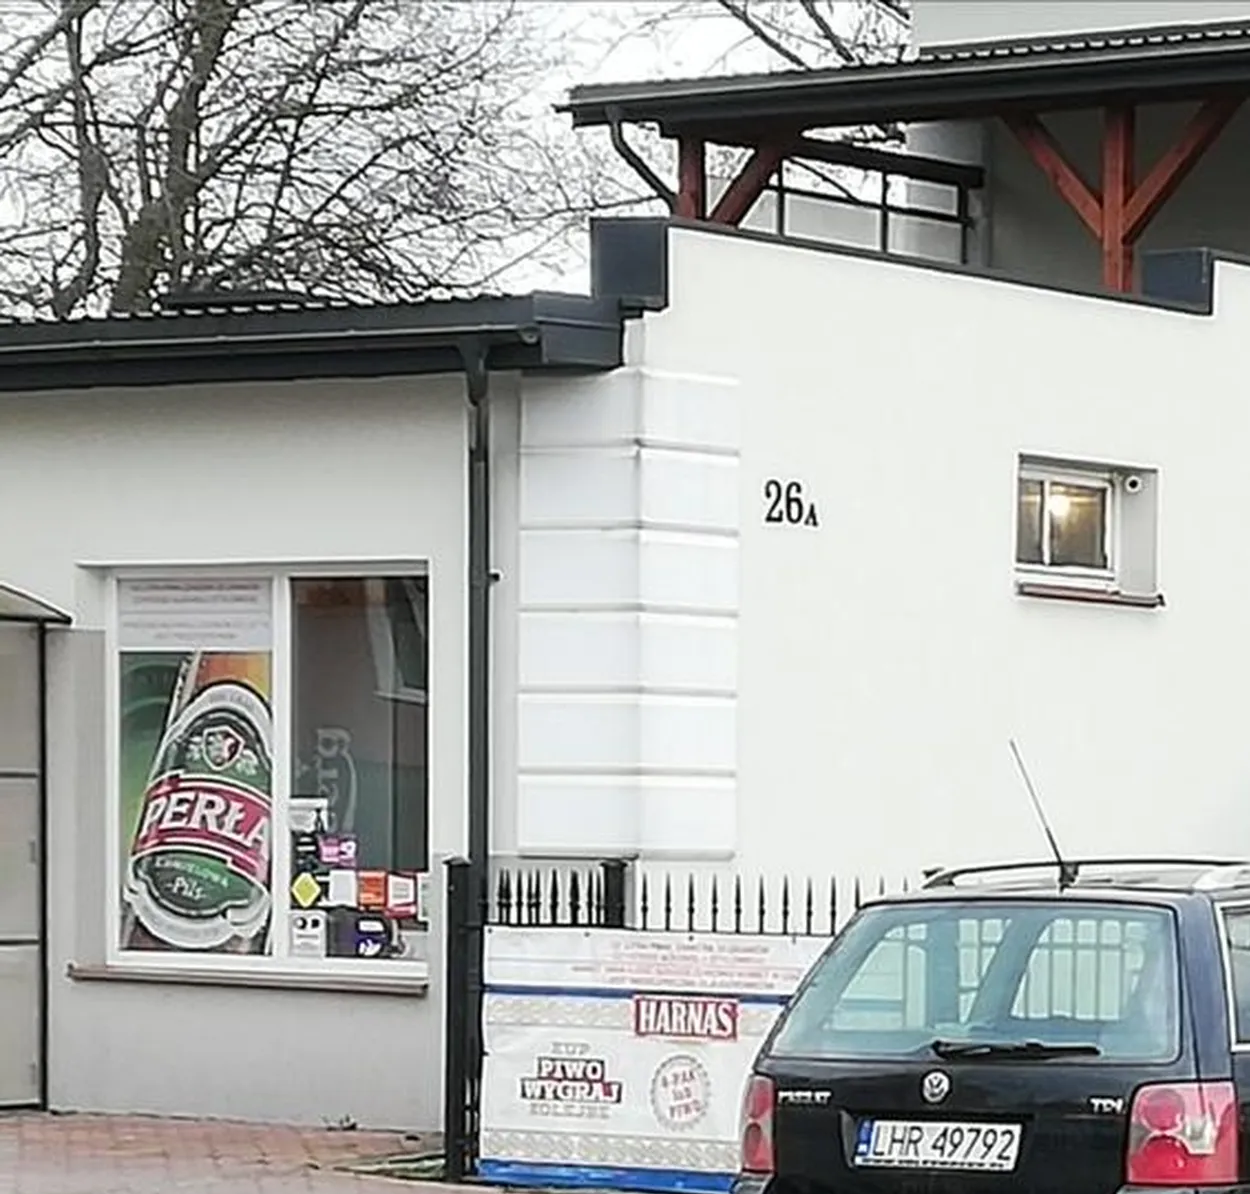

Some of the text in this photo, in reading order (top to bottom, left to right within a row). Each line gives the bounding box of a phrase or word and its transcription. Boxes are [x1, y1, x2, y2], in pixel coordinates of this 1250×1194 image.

[765, 479, 819, 527] 26A
[640, 1000, 733, 1036] HARNAS
[540, 1060, 601, 1080] PIWO
[524, 1080, 619, 1102] WYGRAJ
[872, 1126, 1015, 1161] LHR 49792
